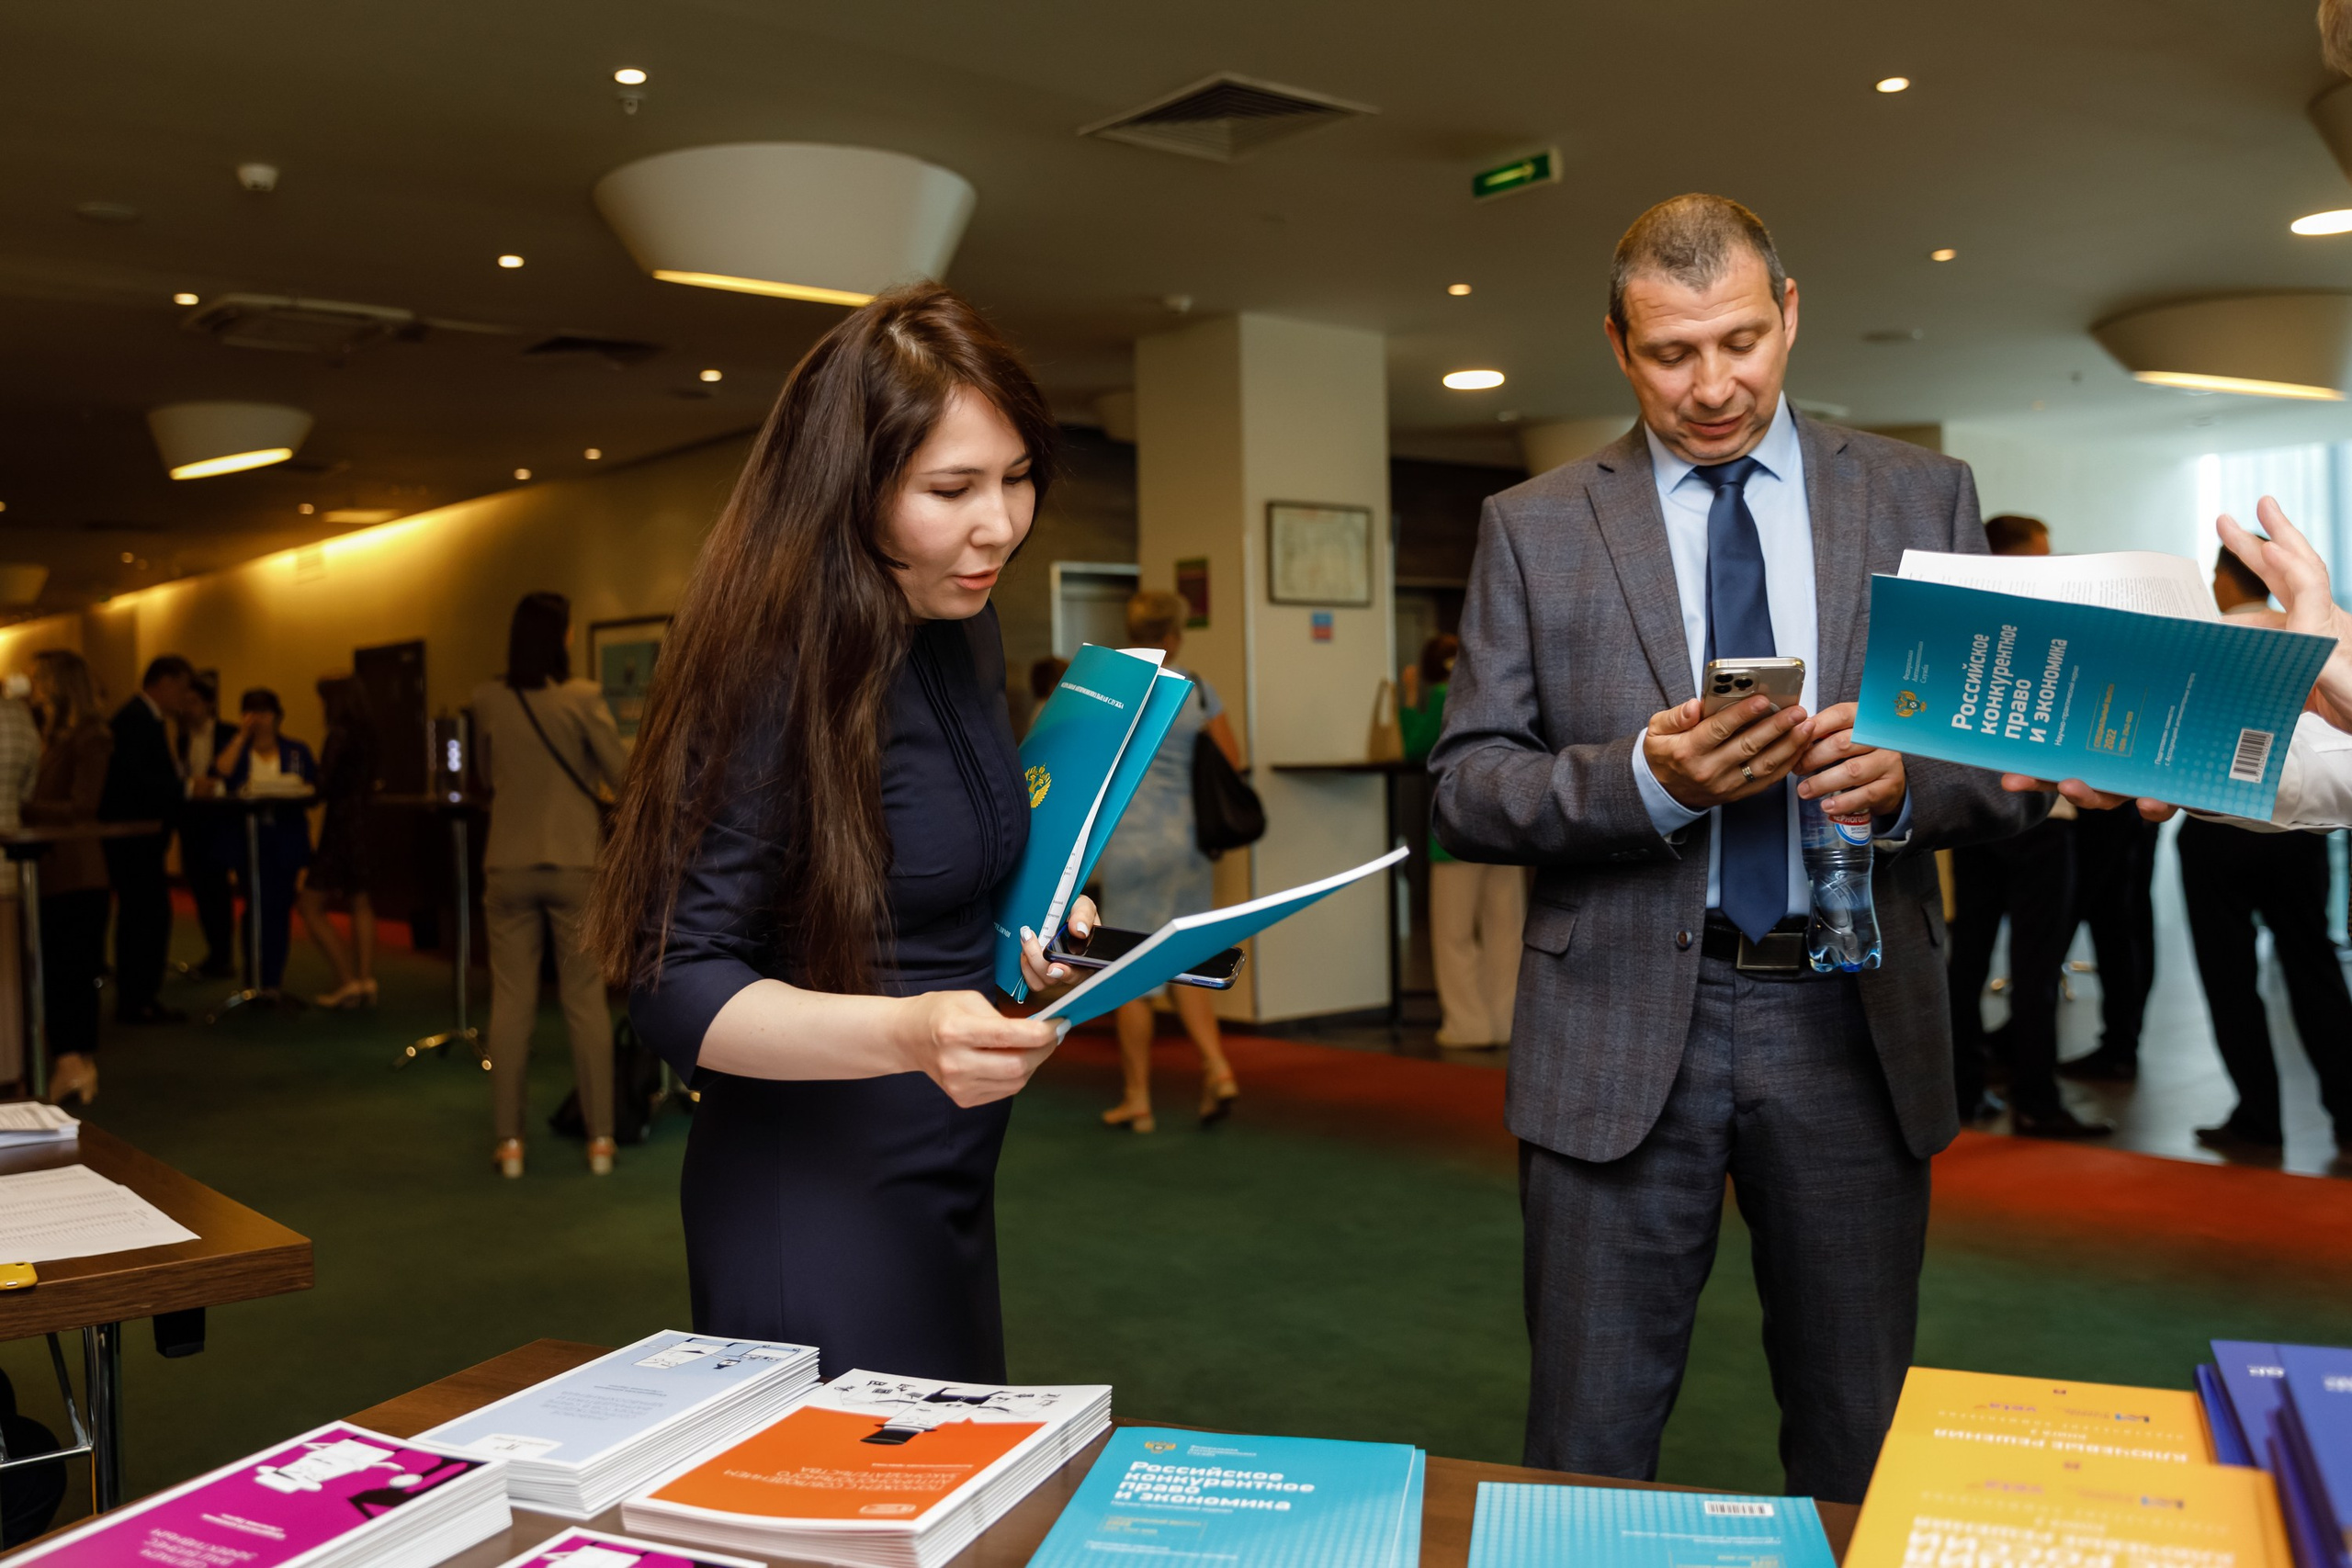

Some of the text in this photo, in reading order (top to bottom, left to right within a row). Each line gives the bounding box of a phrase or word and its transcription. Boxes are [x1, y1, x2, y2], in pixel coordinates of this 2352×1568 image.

[1951, 633, 1990, 730] Российское
[1980, 624, 2018, 735] конкурентное
[2029, 638, 2068, 743] и экономика
[2004, 679, 2032, 739] право
[2103, 728, 2118, 750] 2022
[2051, 1440, 2188, 1463] КЛЮЧЕВЫЕ
[1128, 1461, 1284, 1482] Российское
[1117, 1481, 1202, 1495] право
[1123, 1472, 1317, 1494] конкурентное
[1114, 1490, 1292, 1512] и экономика
